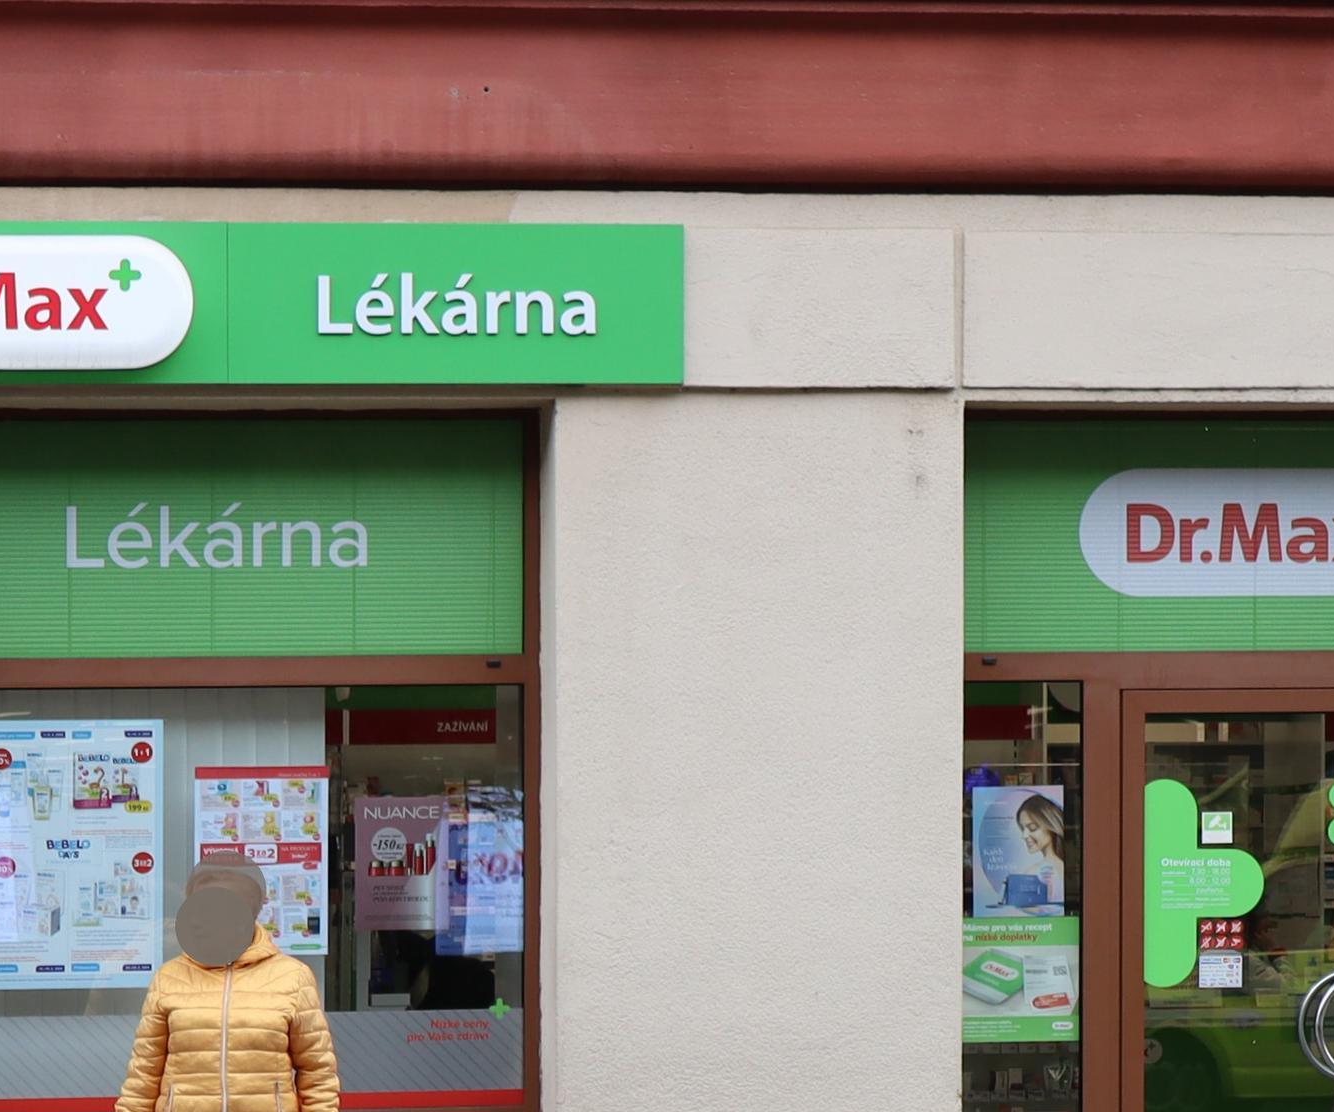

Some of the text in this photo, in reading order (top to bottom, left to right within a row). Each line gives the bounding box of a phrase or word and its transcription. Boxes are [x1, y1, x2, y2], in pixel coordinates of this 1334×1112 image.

[316, 272, 598, 338] Lékárna
[65, 501, 370, 569] Lékárna
[436, 720, 489, 733] ZAŽÍVÁNÍ
[364, 805, 440, 820] NUANCE
[46, 839, 91, 850] BEBELO
[58, 851, 80, 859] DAYS
[1161, 857, 1232, 867] Otevírací doba
